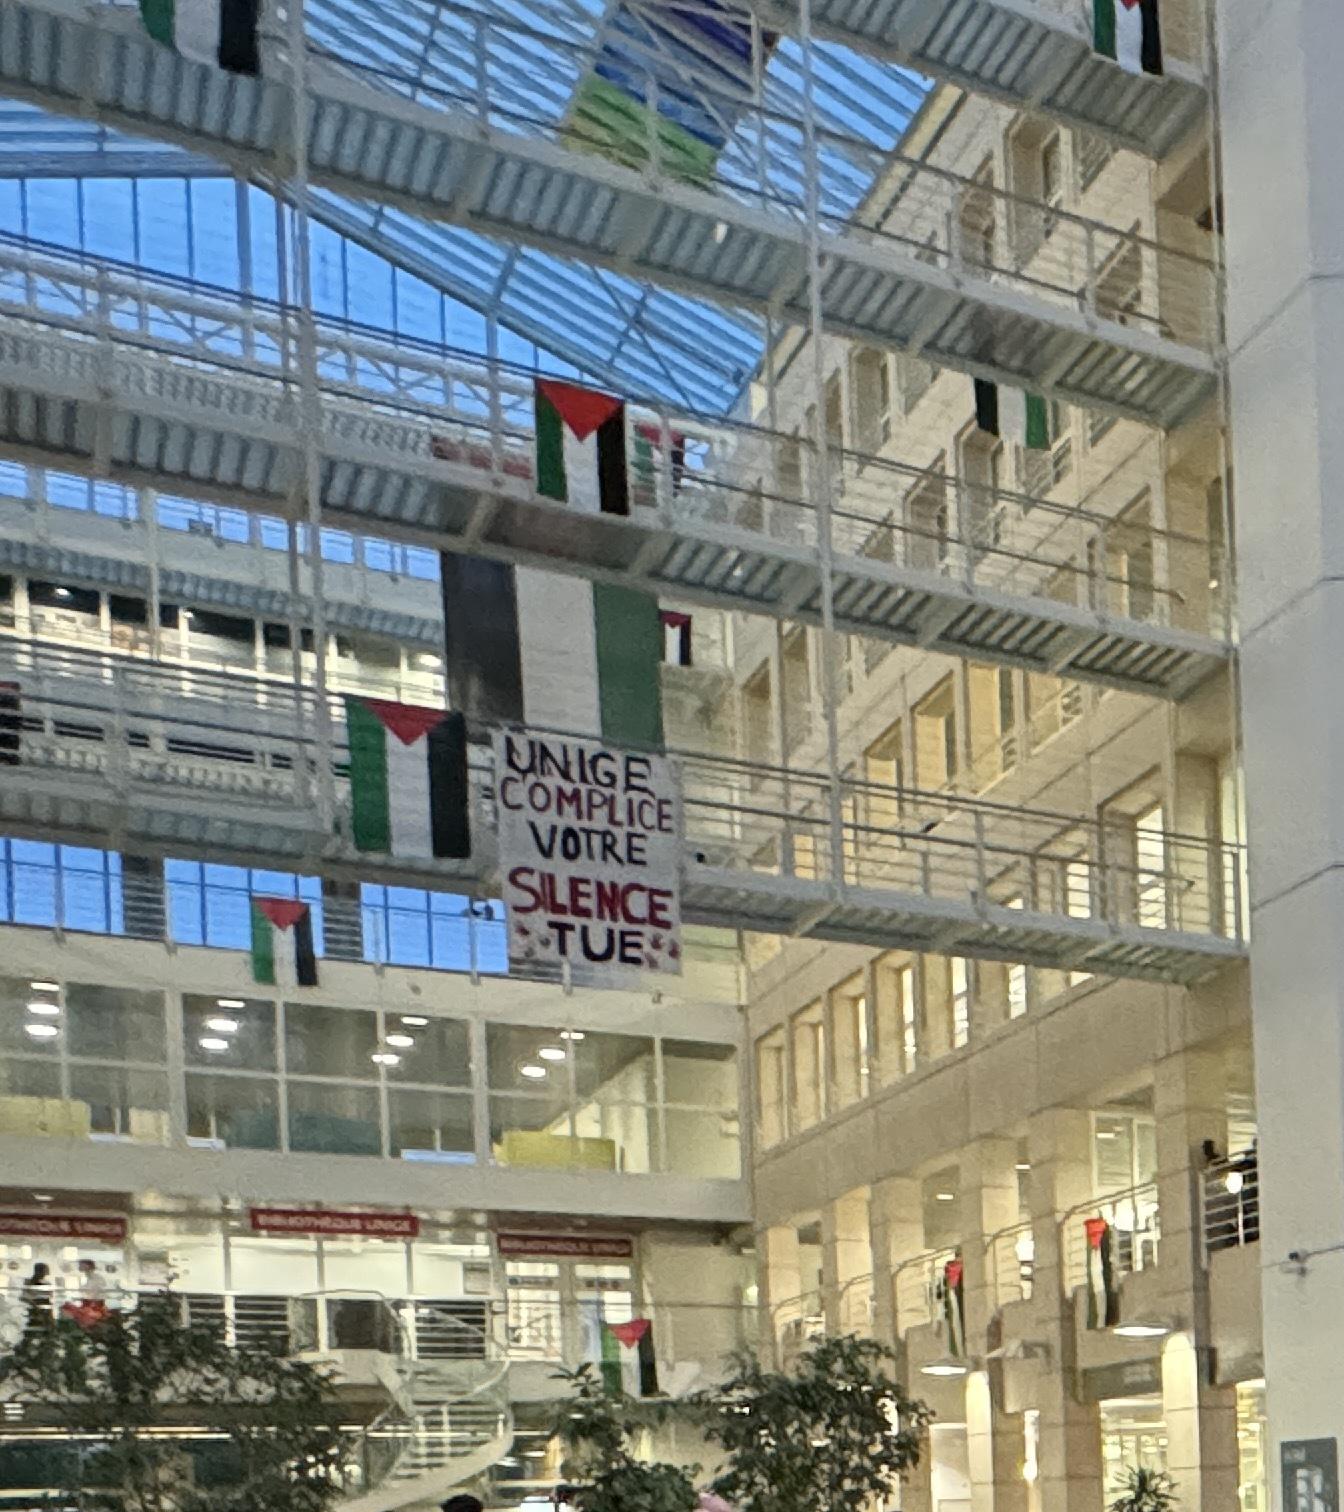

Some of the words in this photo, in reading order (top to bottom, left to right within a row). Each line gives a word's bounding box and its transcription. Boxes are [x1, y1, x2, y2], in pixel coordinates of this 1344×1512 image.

[504, 736, 656, 798] UNIGE
[500, 777, 675, 833] COMPLICE
[527, 821, 649, 866] VOTRE
[508, 866, 674, 930] SILENCE
[547, 921, 645, 965] TUE
